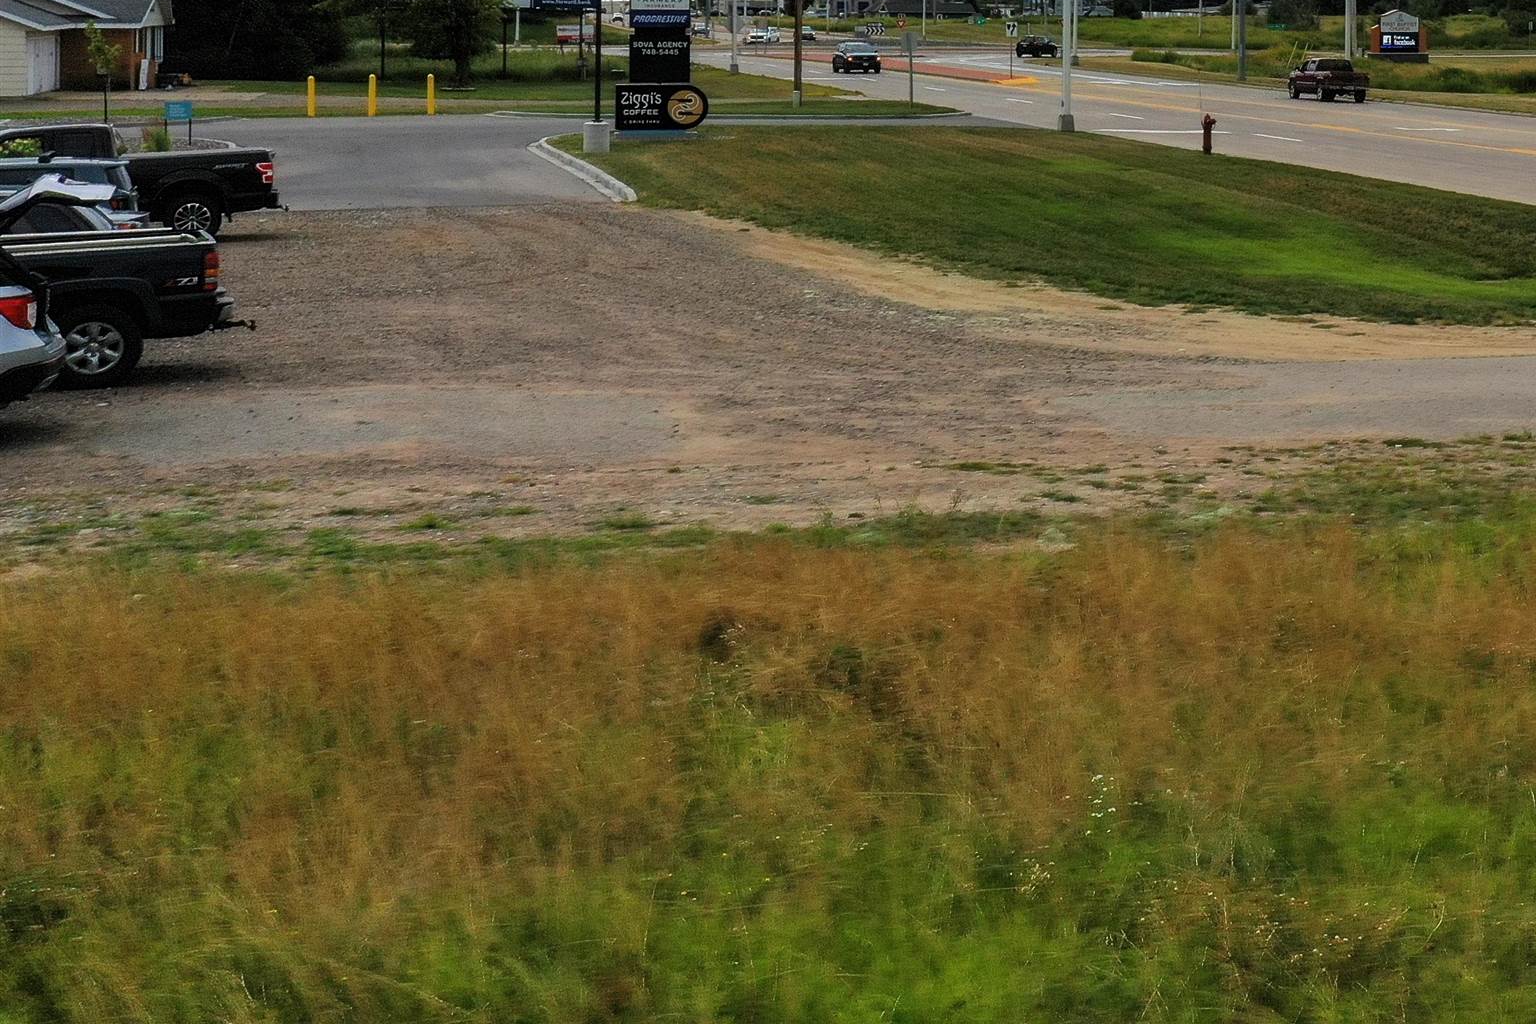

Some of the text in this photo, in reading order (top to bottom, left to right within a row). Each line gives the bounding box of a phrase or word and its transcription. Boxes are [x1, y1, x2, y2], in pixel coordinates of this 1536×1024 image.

[633, 15, 687, 23] PROGRESSIVE
[620, 92, 662, 109] Ziggi's
[176, 276, 198, 286] Z71
